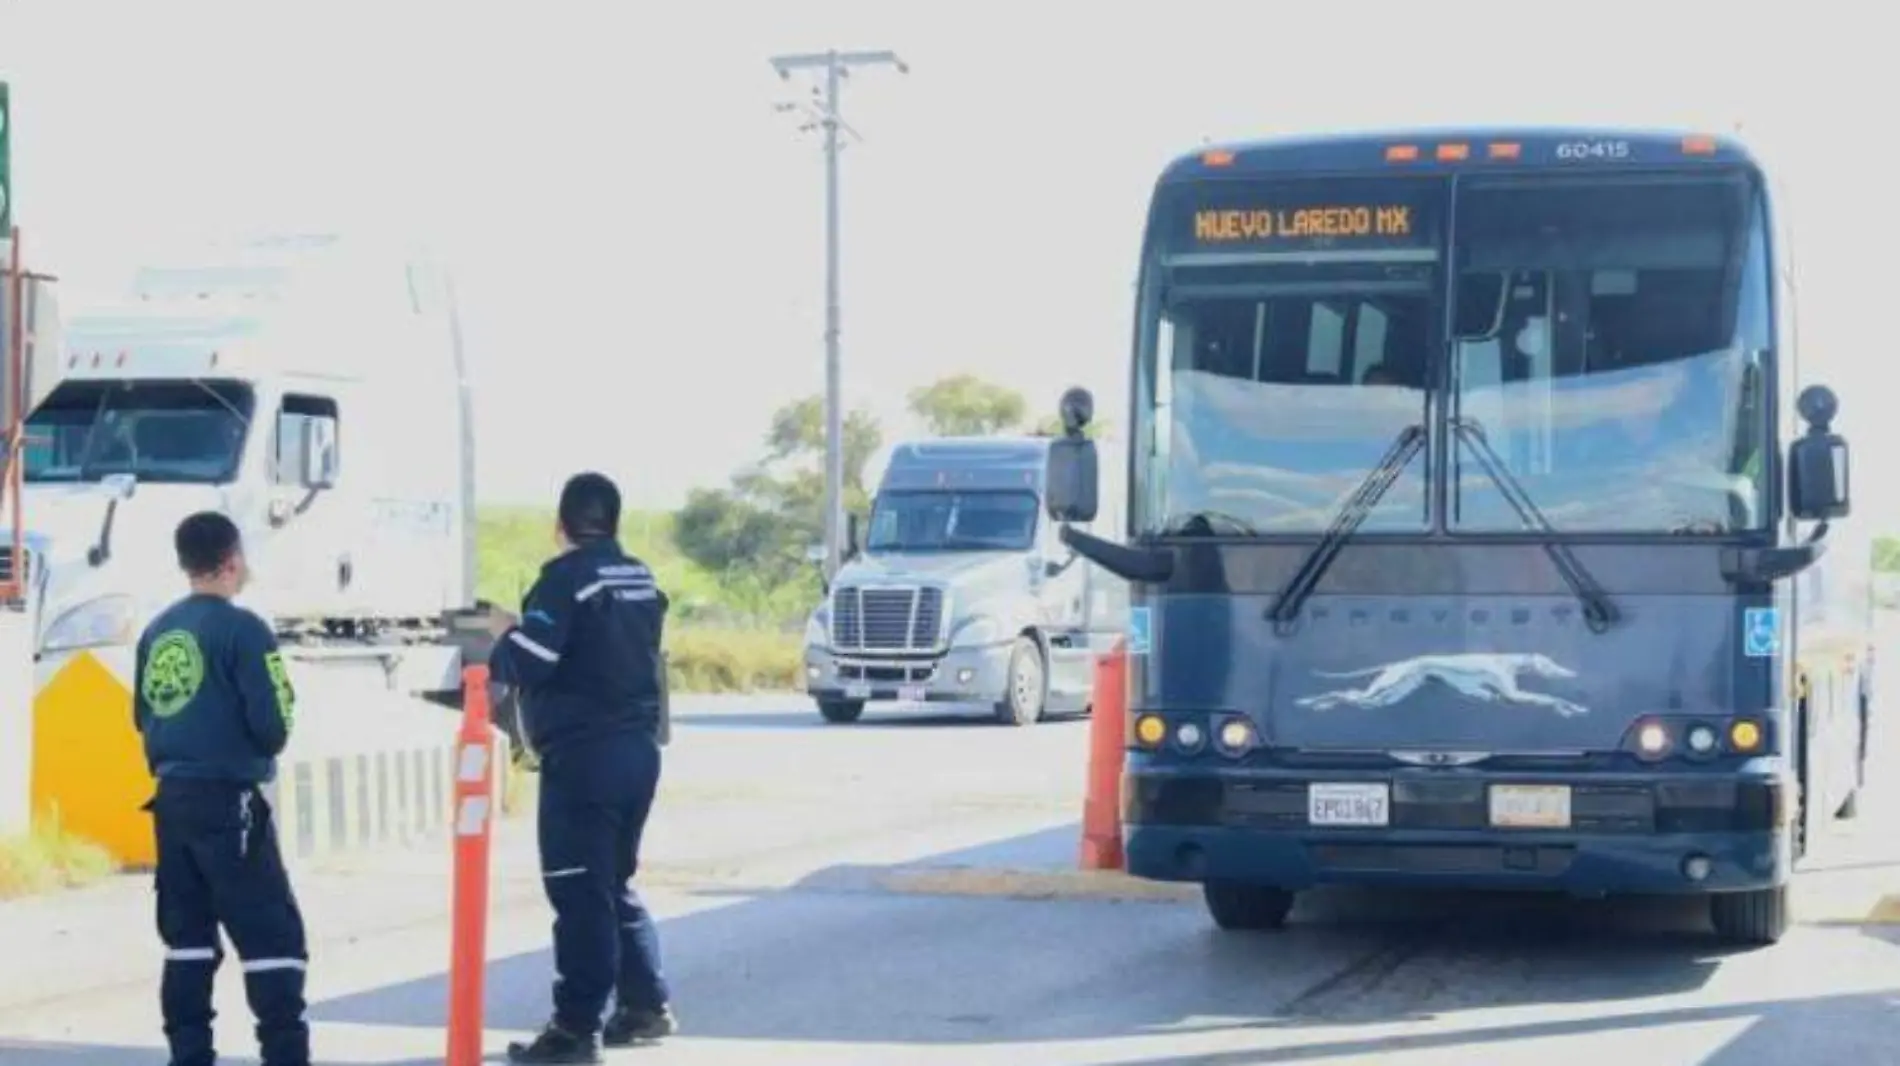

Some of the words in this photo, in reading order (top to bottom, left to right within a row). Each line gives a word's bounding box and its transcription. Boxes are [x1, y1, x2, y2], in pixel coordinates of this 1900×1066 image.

[1556, 142, 1629, 159] 60415
[1195, 209, 1272, 239] NUEVO
[1278, 206, 1370, 237] LAREDO
[1377, 204, 1412, 235] MX
